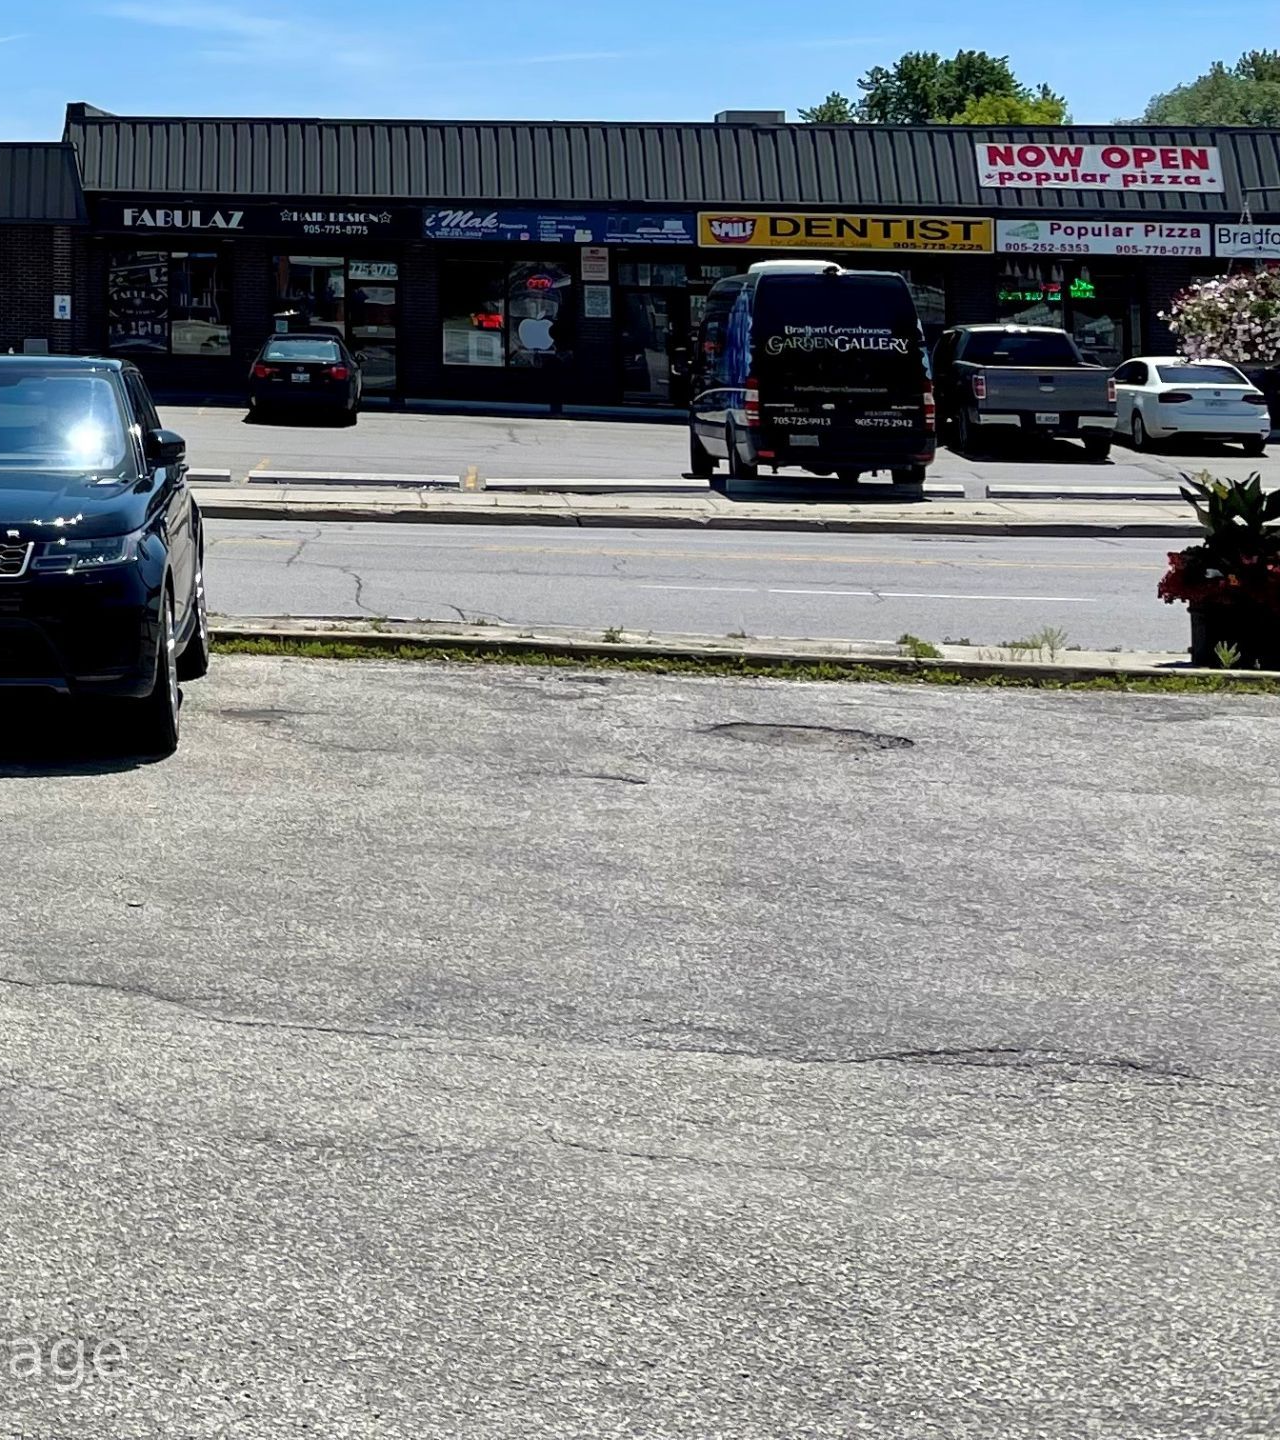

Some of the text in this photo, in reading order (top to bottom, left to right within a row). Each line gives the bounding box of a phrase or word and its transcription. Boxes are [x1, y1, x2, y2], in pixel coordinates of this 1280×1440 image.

[986, 145, 1210, 170] NOW OPEN
[998, 169, 1201, 187] popular pizza
[123, 209, 244, 229] FABULAZ
[293, 212, 379, 223] HAIR DESIGN
[303, 225, 368, 235] 905-775-8775
[710, 219, 753, 237] SMILE
[769, 217, 983, 241] DENTIST
[1049, 222, 1201, 240] Popular Pizza
[1005, 243, 1090, 253] 905-252-5353
[1115, 244, 1202, 256] 905-778-0778
[784, 325, 892, 337] Bradford Greenhouses
[773, 417, 831, 426] 705-725-9913
